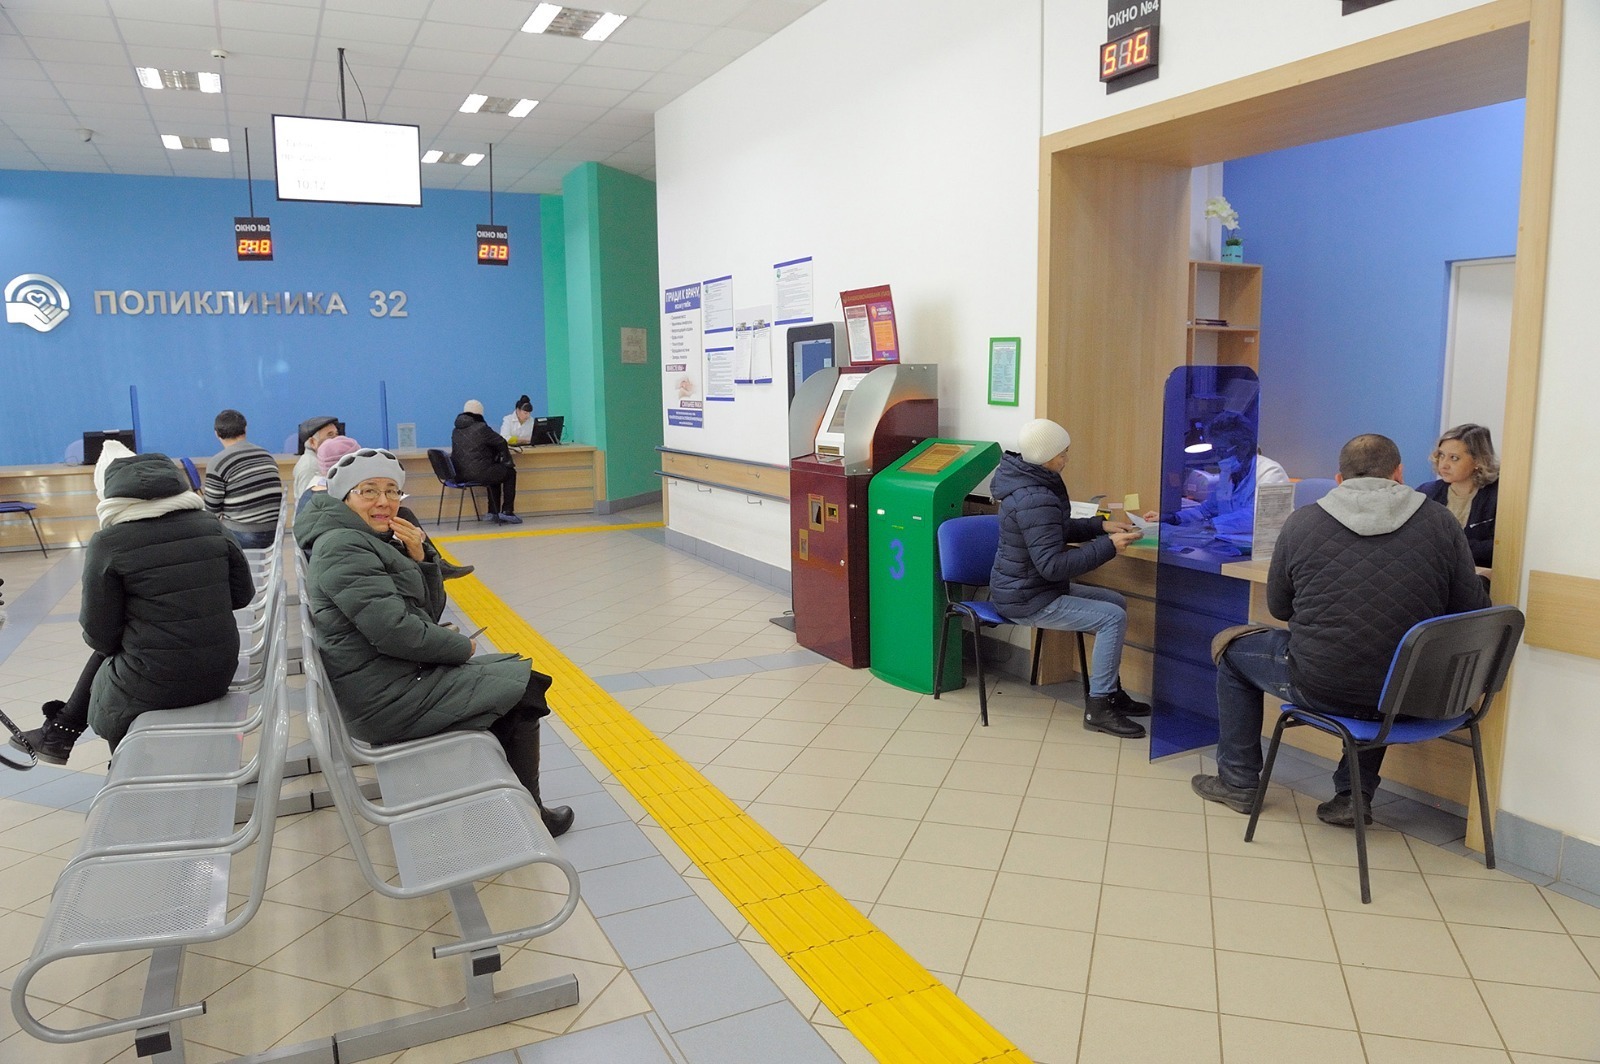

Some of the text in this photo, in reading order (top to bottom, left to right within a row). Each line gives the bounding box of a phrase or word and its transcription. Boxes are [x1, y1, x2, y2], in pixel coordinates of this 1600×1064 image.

[1108, 0, 1159, 29] ОКНО №4
[1102, 31, 1149, 75] 516
[235, 224, 271, 232] ОКНО №2
[476, 230, 496, 239] ОКНО
[238, 239, 272, 255] 248
[478, 244, 508, 260] 273
[93, 289, 408, 318] ПОЛИКЛИНИКА 32
[889, 538, 905, 580] 3
